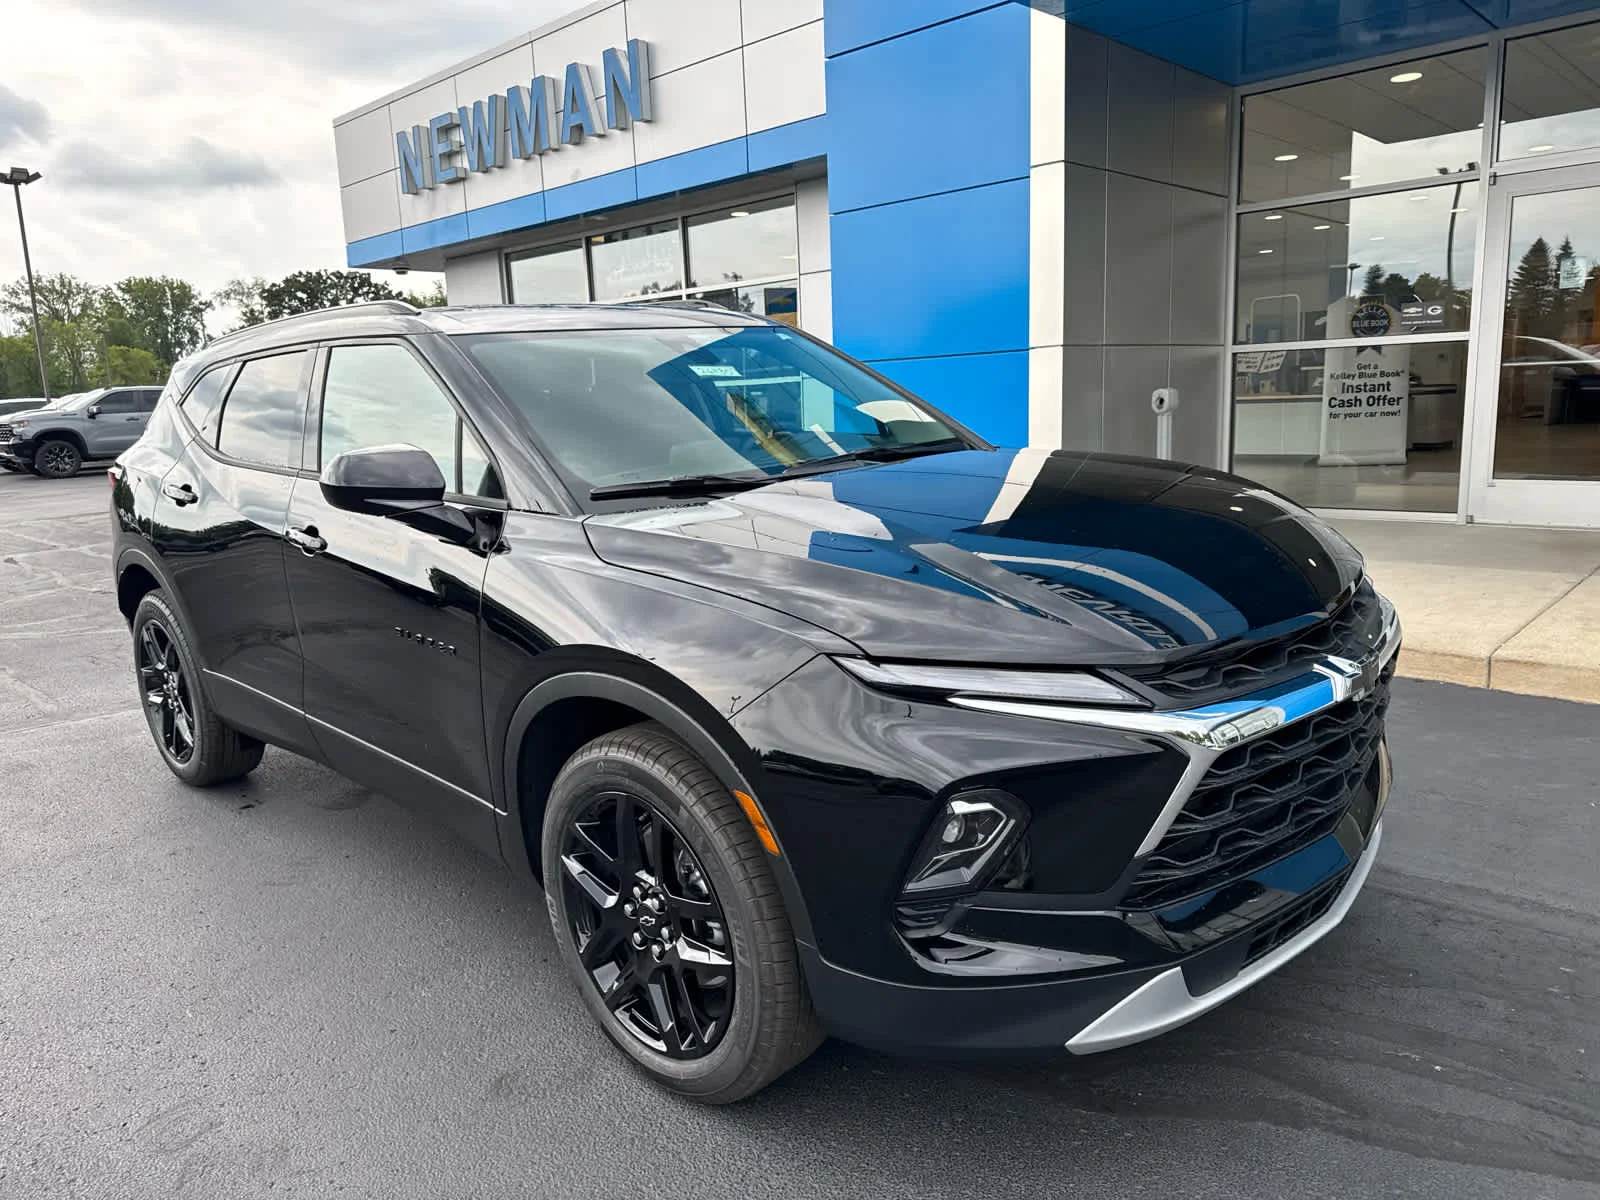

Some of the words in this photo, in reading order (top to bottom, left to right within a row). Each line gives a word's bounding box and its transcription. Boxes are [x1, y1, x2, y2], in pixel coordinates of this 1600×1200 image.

[397, 38, 652, 194] NEWMAN
[1352, 320, 1370, 328] BLUE
[1371, 319, 1389, 327] BOOK
[1330, 372, 1356, 380] Kelley
[1358, 371, 1378, 379] Blue
[1341, 381, 1391, 394] Instant
[1328, 396, 1362, 408] Cash
[1366, 394, 1404, 407] Offer
[1343, 411, 1362, 420] your
[1380, 409, 1401, 417] now!
